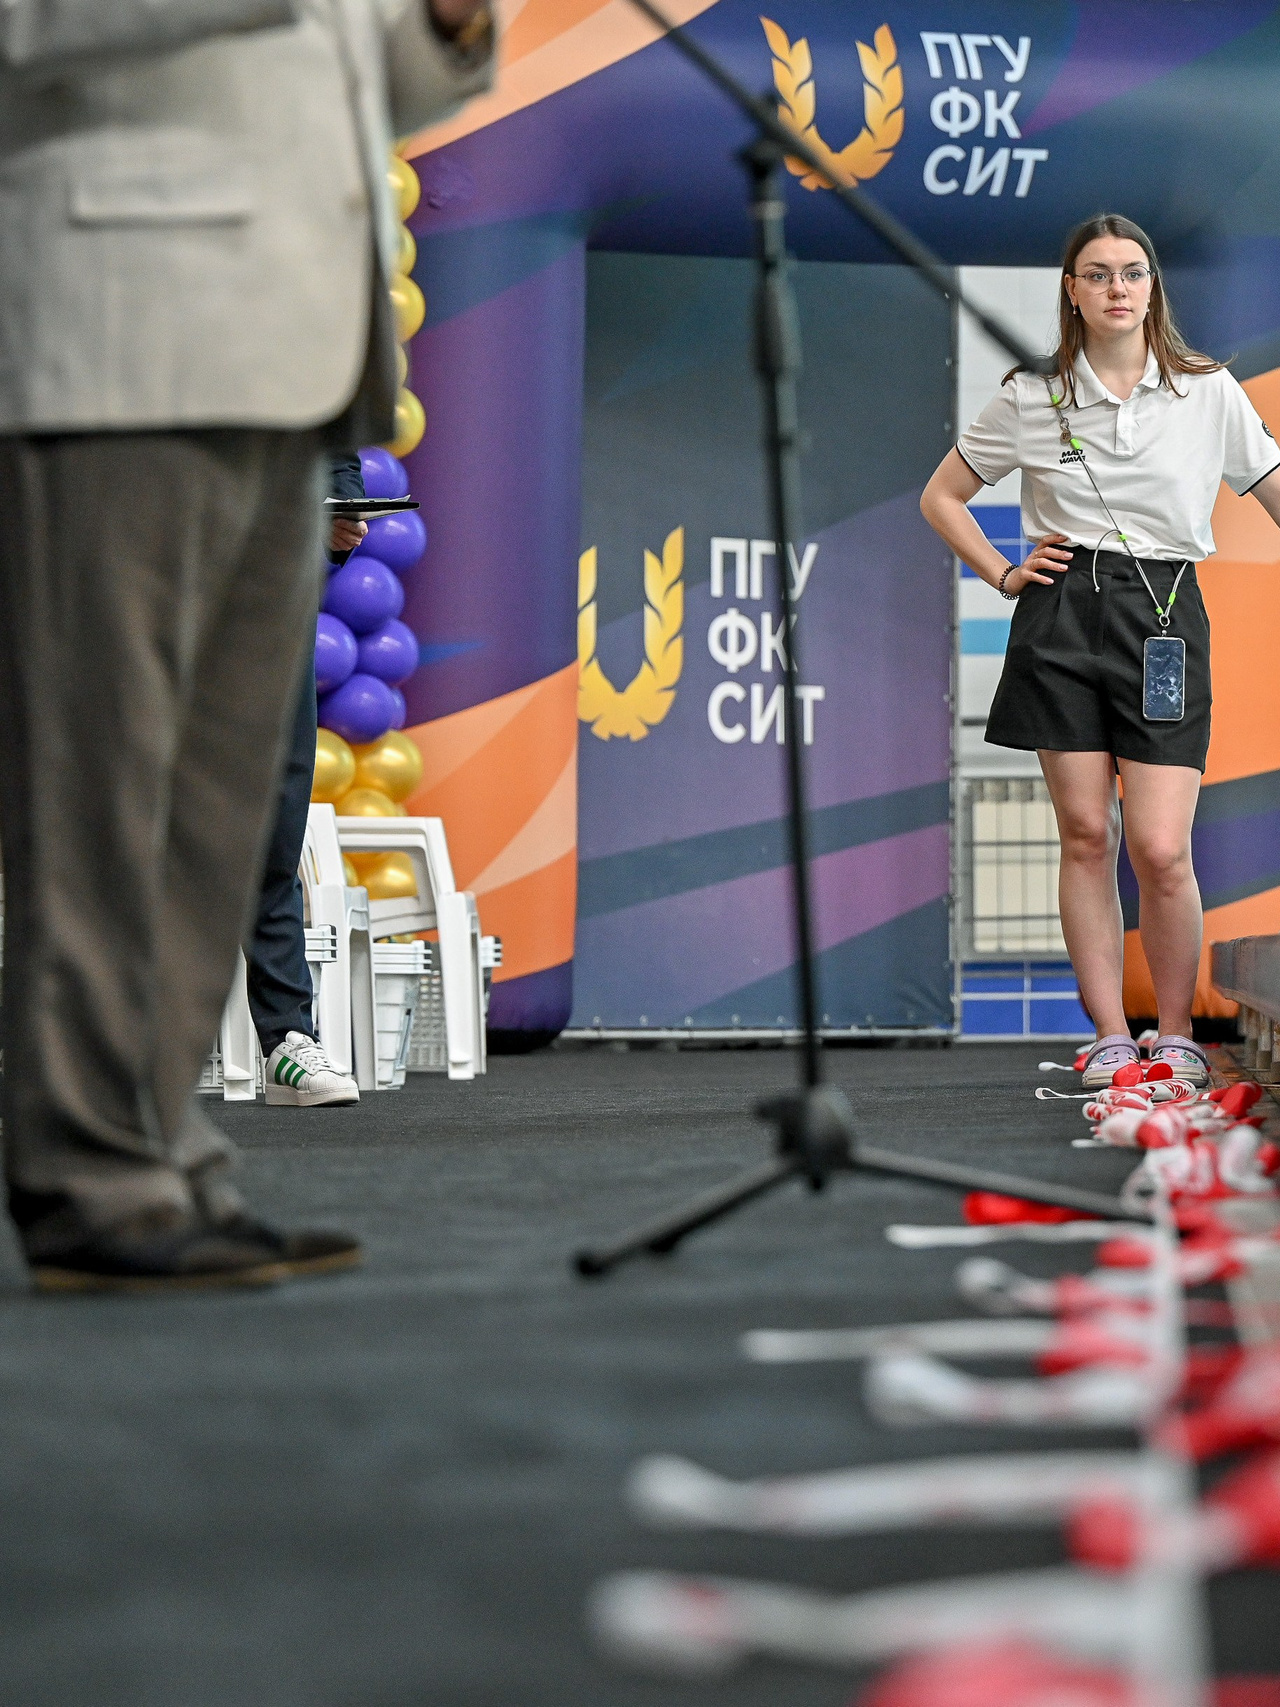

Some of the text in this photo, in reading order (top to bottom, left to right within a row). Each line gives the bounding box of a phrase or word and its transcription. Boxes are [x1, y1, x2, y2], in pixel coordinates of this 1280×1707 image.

[920, 31, 1032, 83] ПГУ
[929, 86, 1023, 139] ФК
[922, 144, 1050, 198] СИТ
[709, 536, 819, 601] ПГУ
[707, 607, 798, 673] ФК
[707, 680, 826, 745] СИТ
